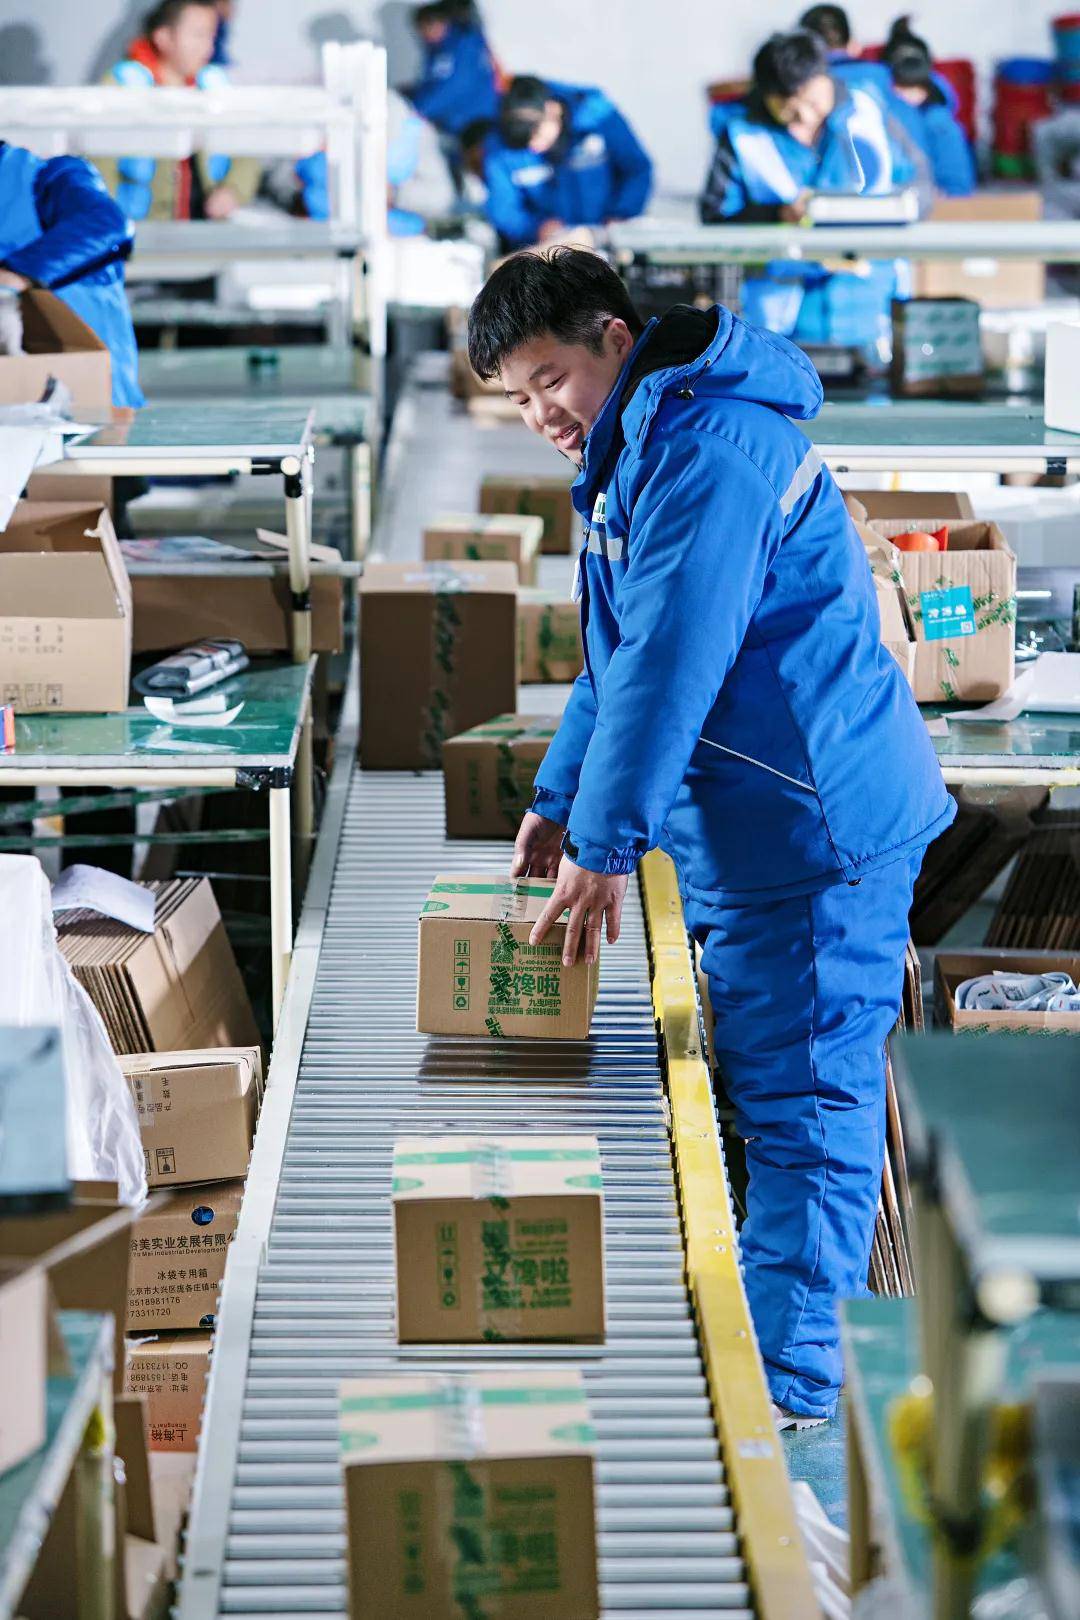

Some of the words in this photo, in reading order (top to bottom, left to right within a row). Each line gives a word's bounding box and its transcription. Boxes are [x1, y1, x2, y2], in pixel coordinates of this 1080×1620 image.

[157, 1268, 208, 1280] 冰袋专用箱
